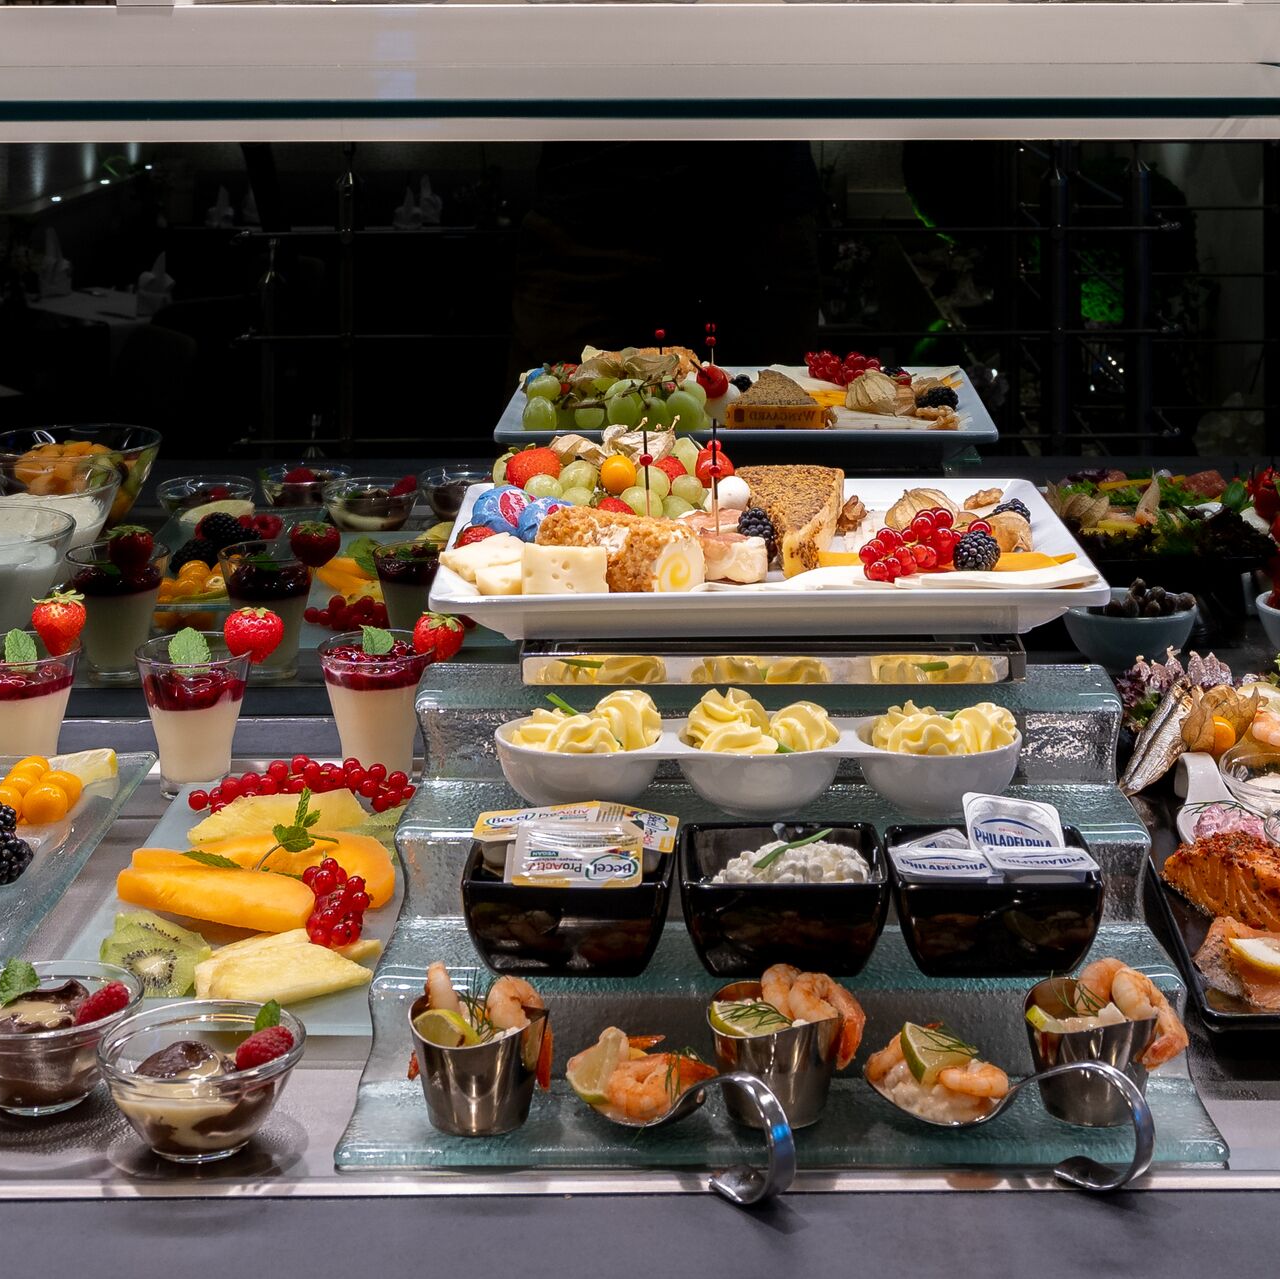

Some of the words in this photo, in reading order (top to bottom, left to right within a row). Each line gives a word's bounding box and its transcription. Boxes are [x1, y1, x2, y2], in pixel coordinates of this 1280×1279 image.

[491, 814, 528, 824] Becel
[973, 826, 1053, 848] PHILADELPHIA
[593, 863, 632, 876] Becel
[900, 858, 988, 871] PHILADELPHIA
